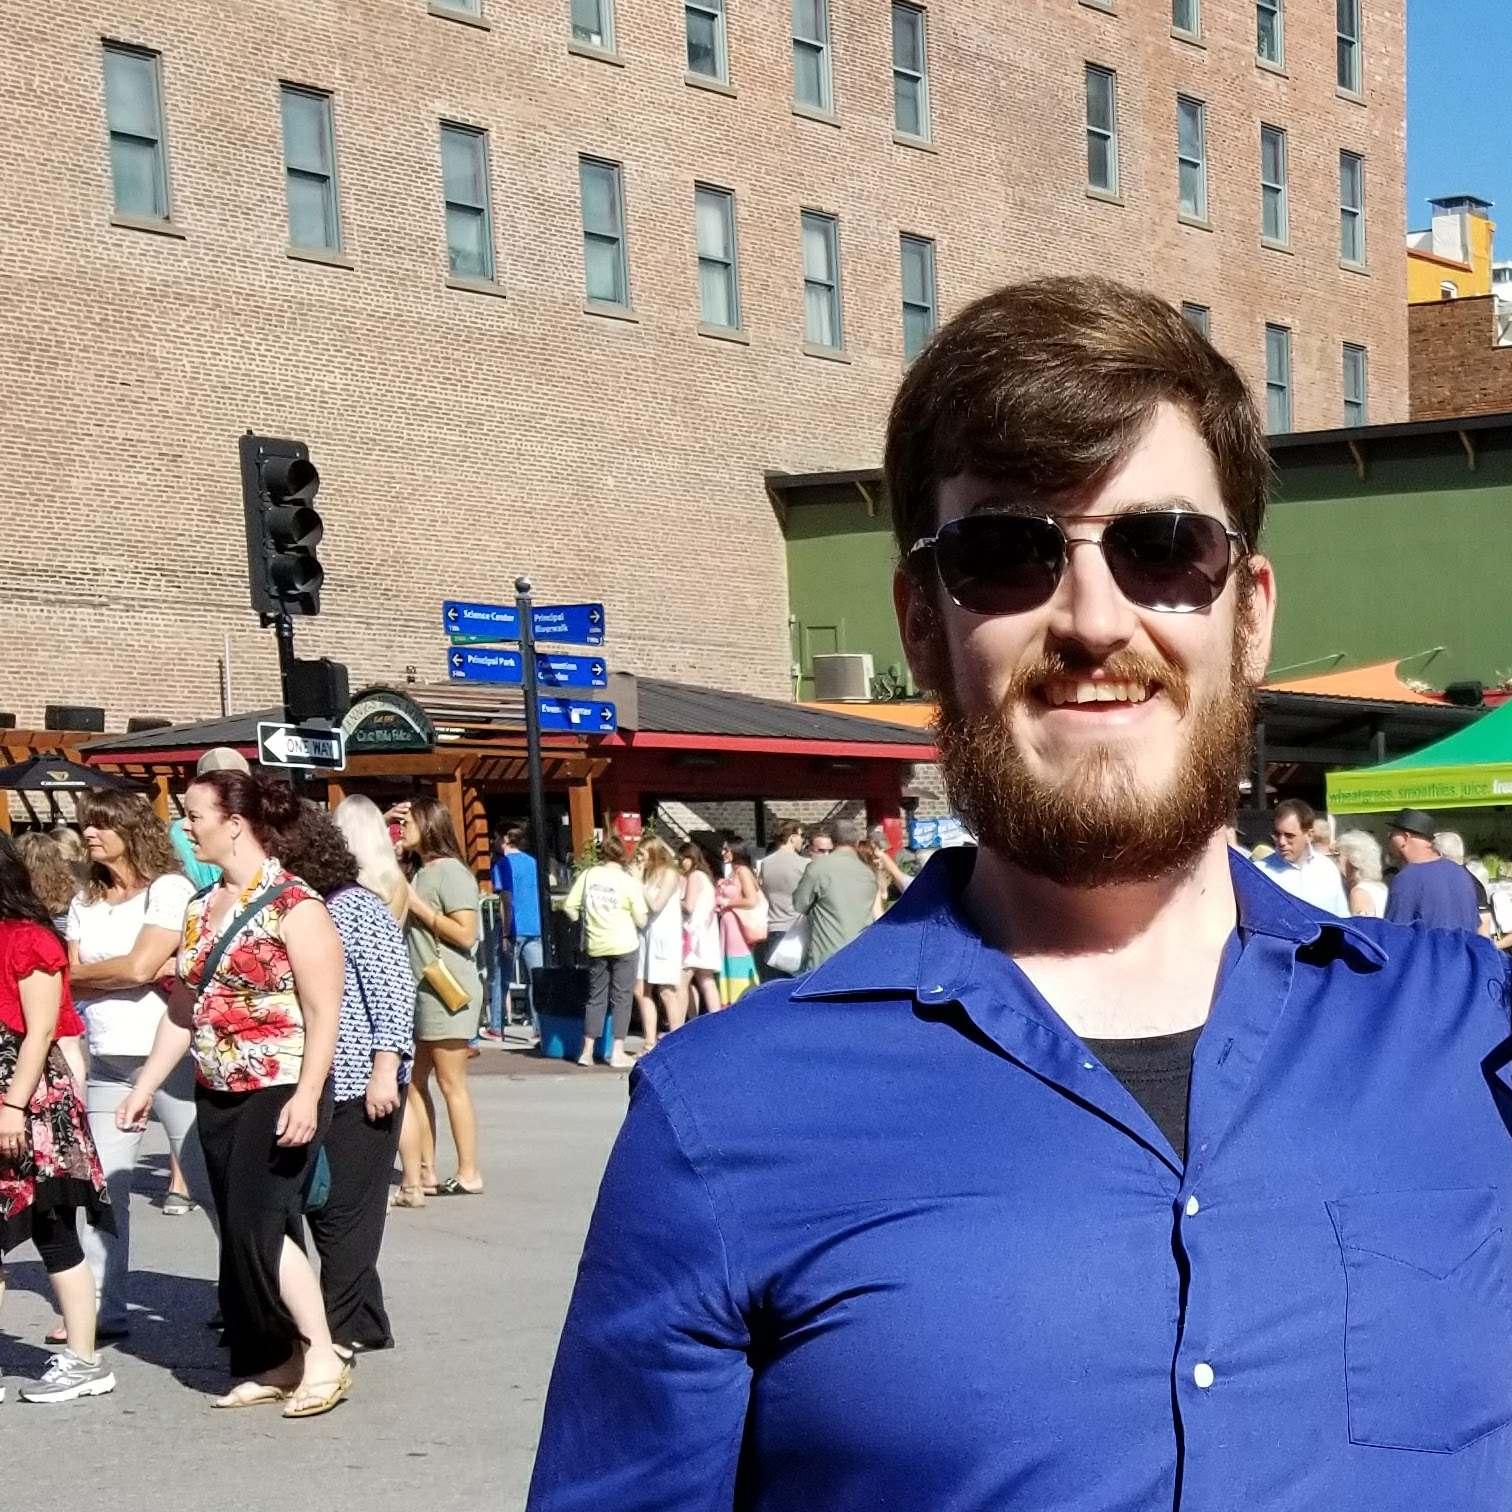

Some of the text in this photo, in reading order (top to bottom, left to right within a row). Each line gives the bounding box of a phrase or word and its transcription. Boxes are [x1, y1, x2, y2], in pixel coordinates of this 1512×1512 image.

[463, 609, 515, 622] Science Center
[467, 654, 516, 667] Principal Park
[287, 738, 334, 757] ONE WAY
